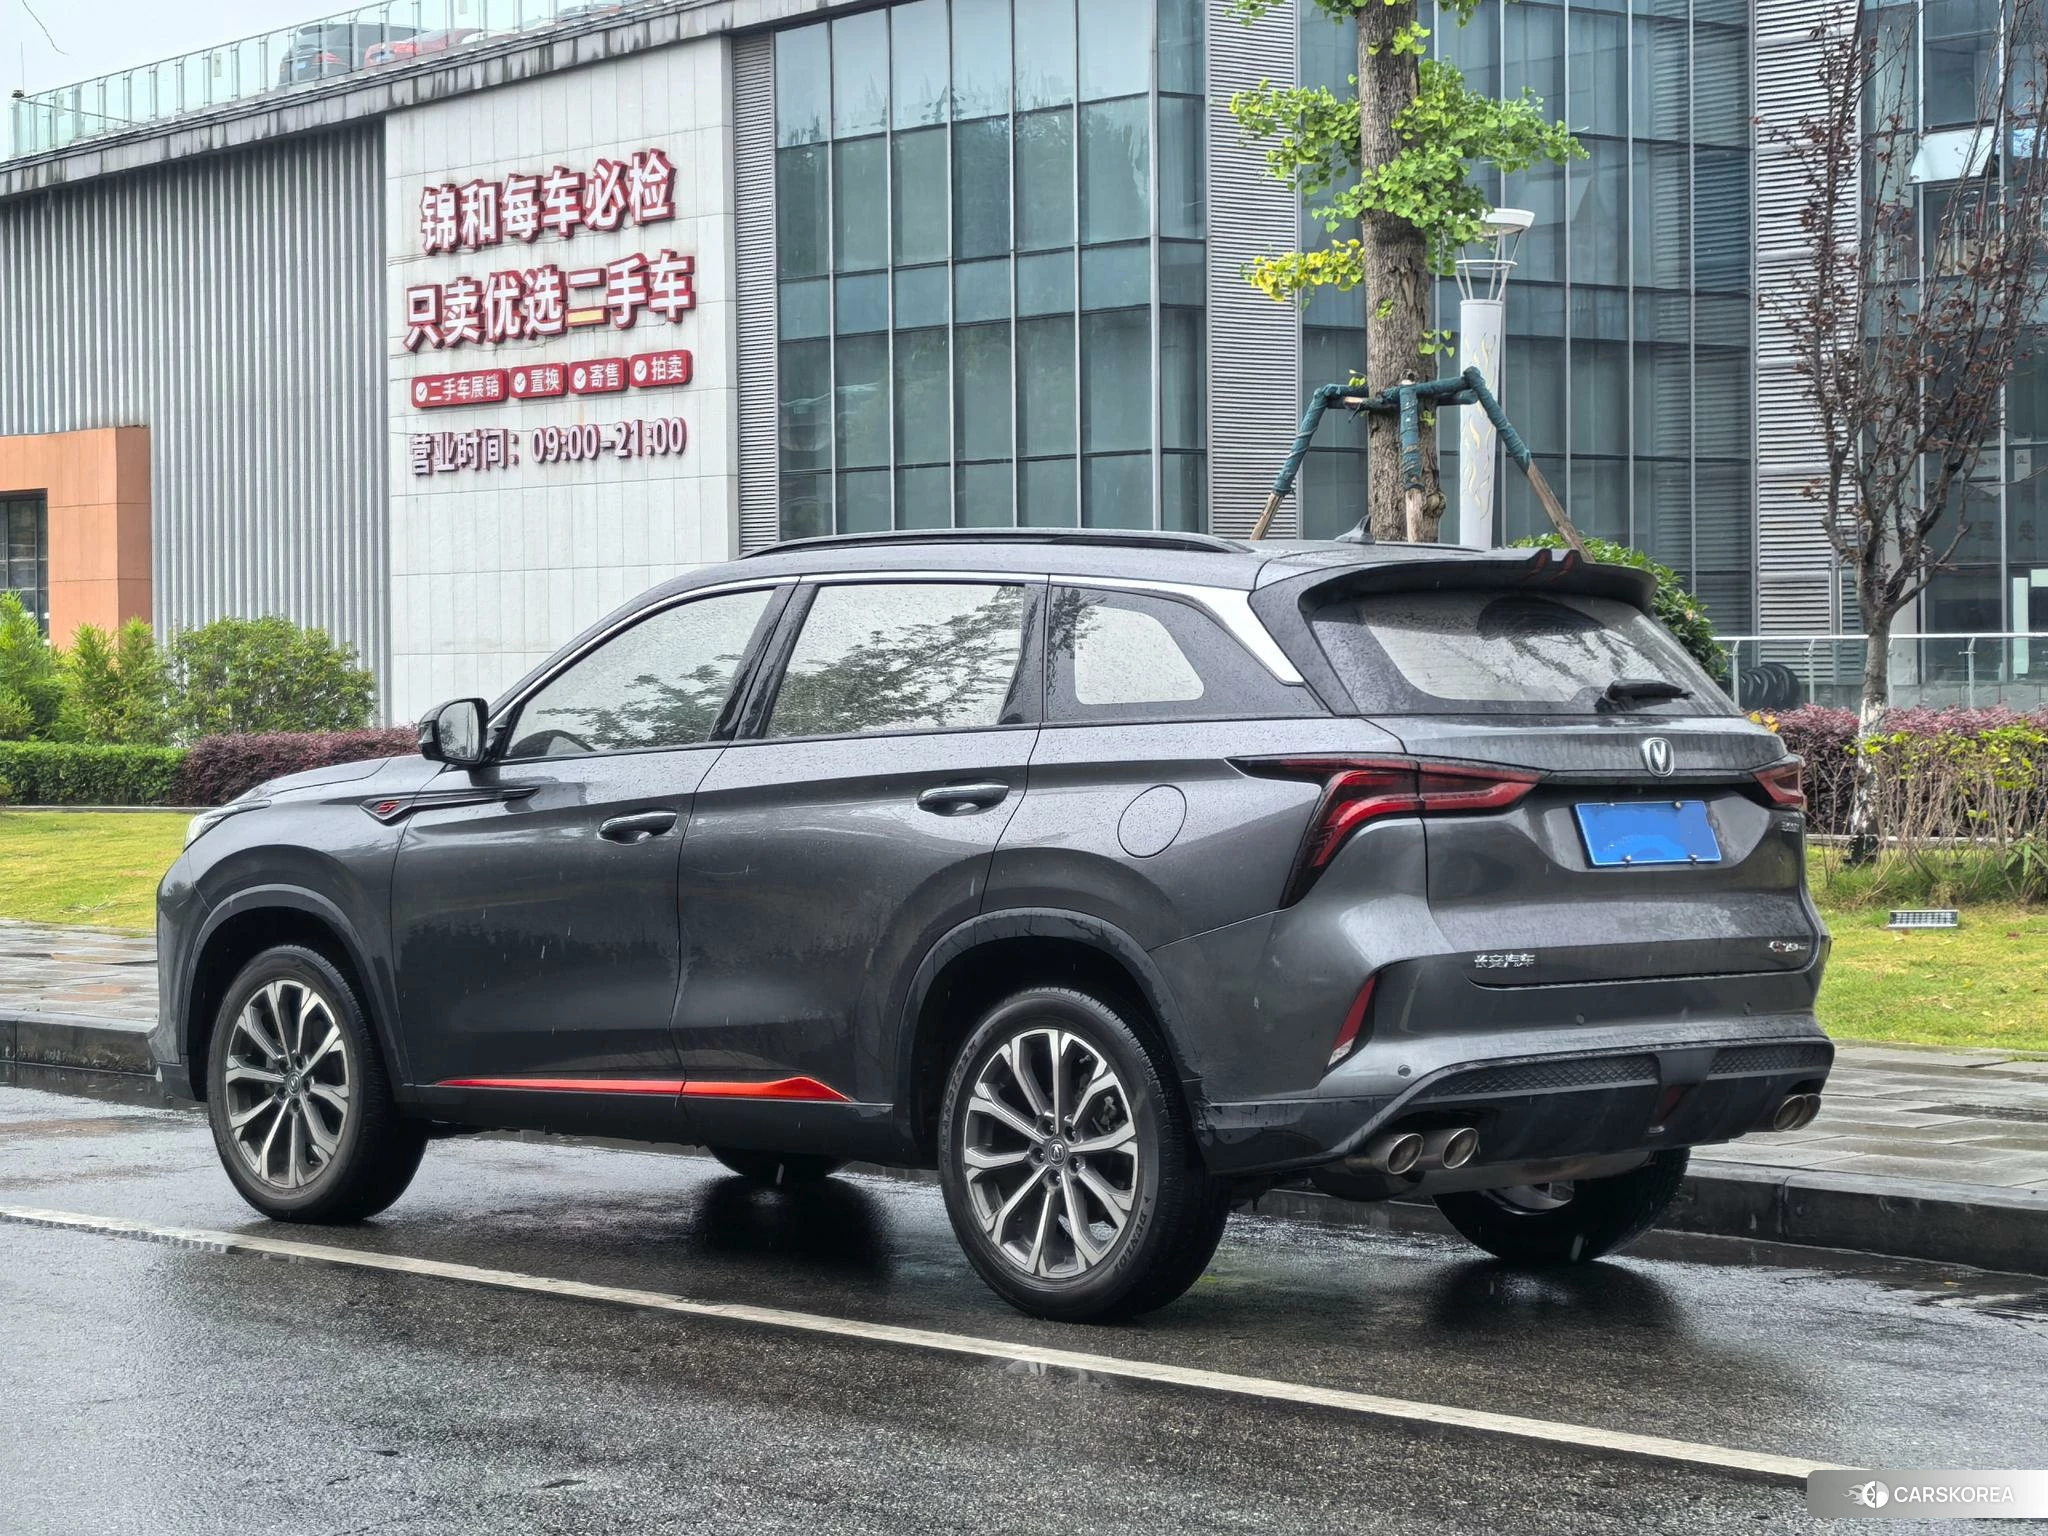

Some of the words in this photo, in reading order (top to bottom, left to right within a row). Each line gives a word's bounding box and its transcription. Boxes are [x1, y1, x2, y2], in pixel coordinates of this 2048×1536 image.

[421, 149, 676, 255] 锦和每车必检
[404, 249, 694, 352] 只卖优选二手车
[530, 368, 562, 393] 置换
[589, 363, 620, 388] 寄售
[651, 354, 684, 380] 拍卖
[429, 374, 500, 401] 二手车展销
[531, 416, 687, 463] 09:00-21:00
